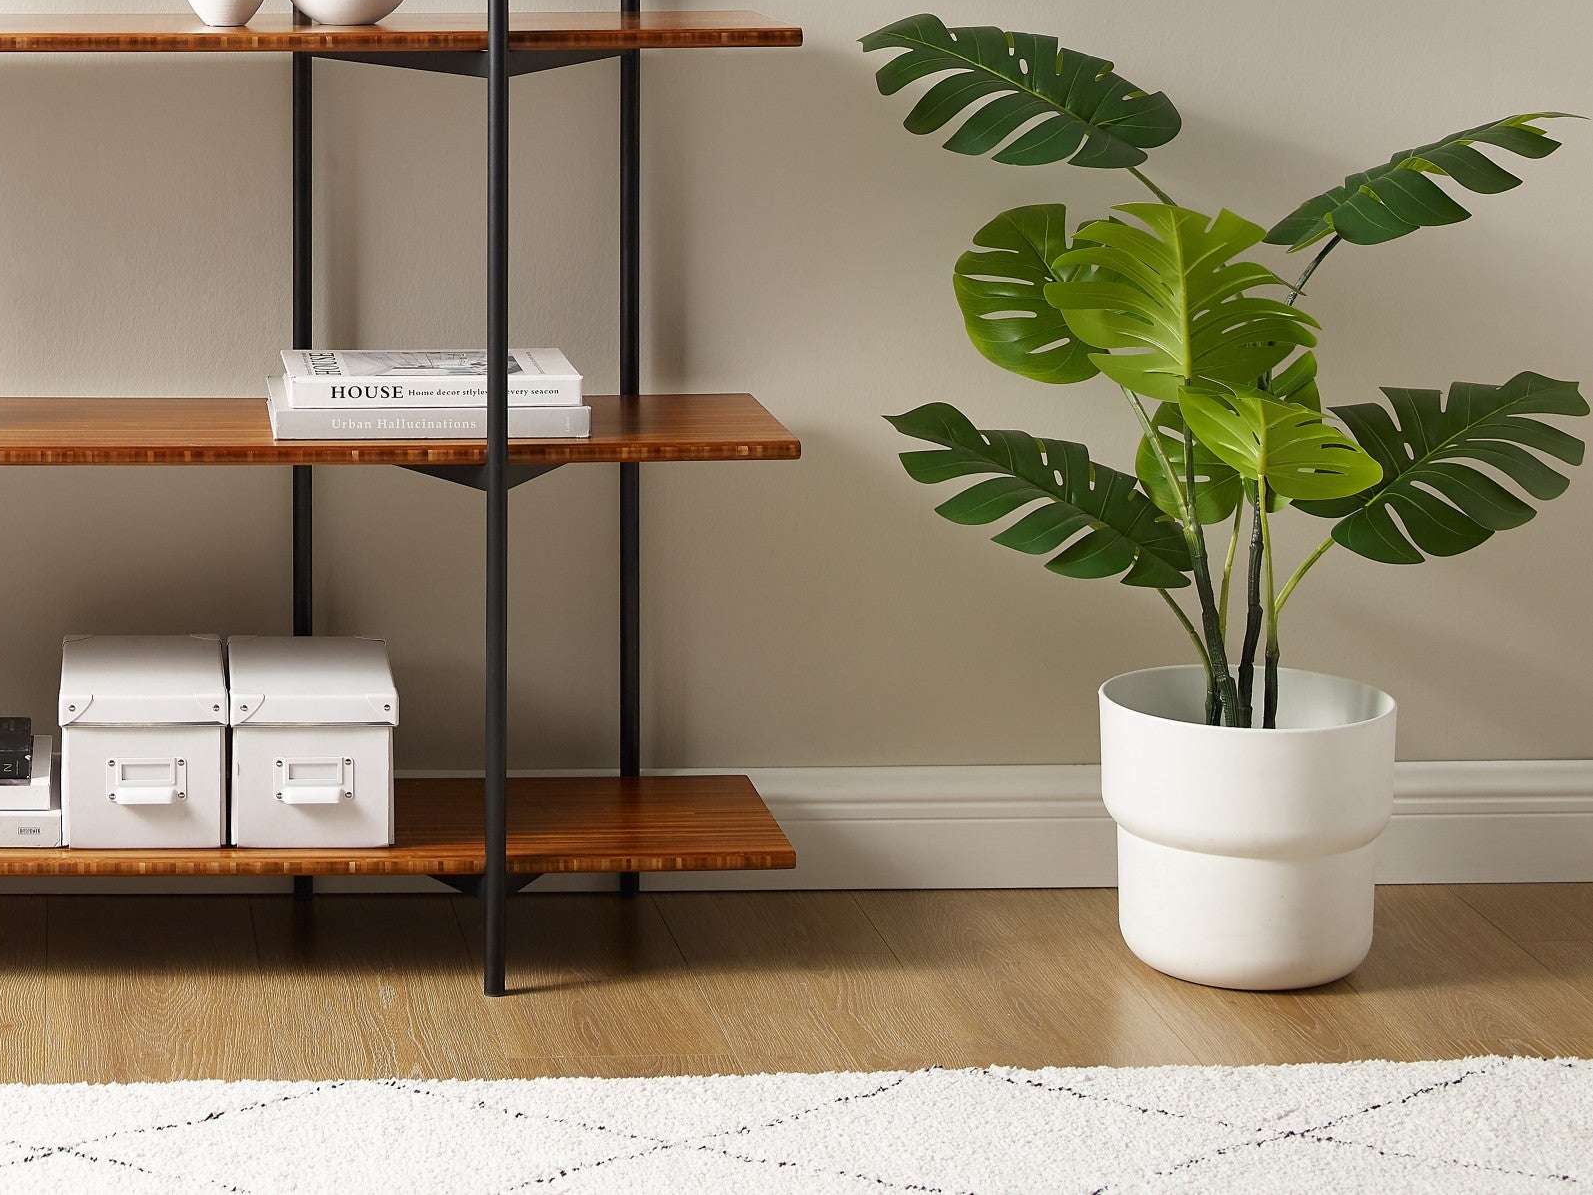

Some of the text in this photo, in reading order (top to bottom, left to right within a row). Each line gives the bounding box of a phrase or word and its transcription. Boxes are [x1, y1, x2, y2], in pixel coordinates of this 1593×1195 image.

[330, 385, 404, 399] HOUSE
[407, 388, 434, 396] Home
[436, 388, 461, 396] decor
[331, 418, 477, 429] Urban Hallucinations
